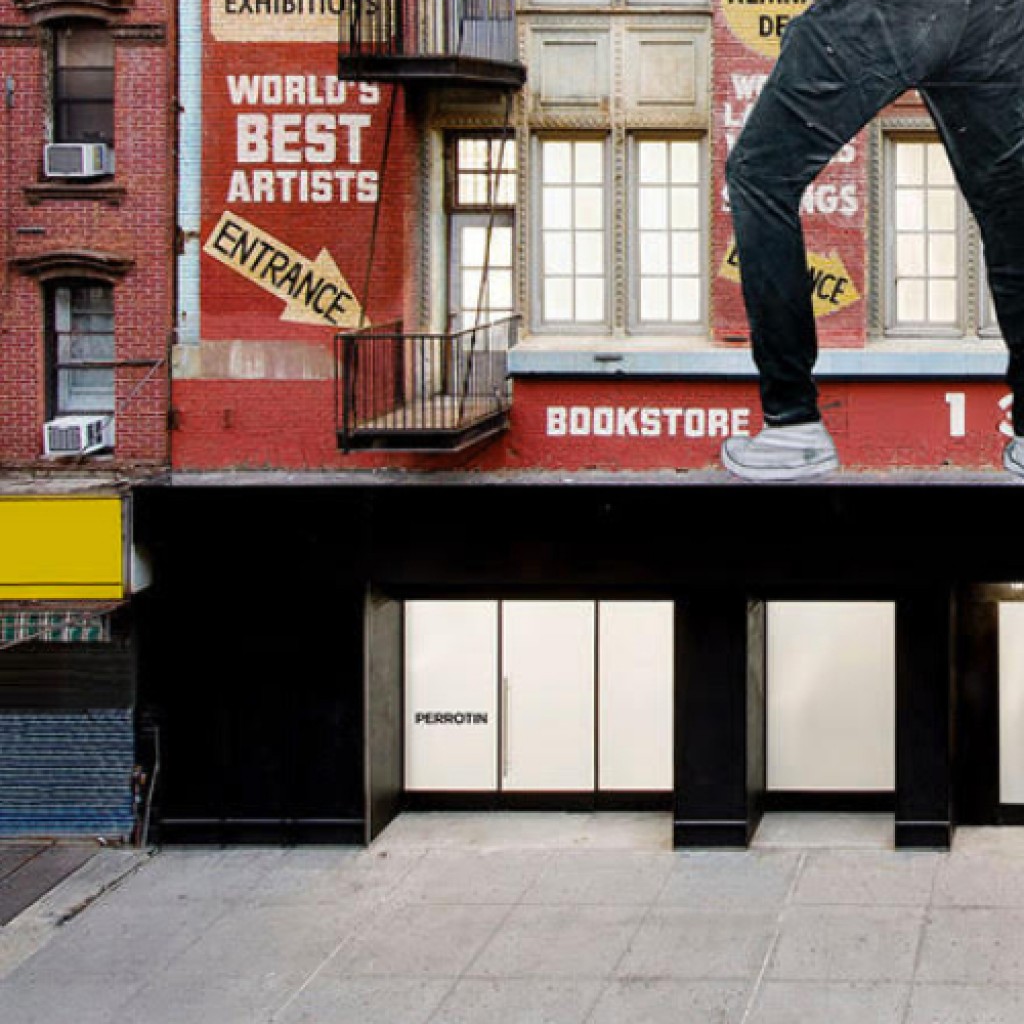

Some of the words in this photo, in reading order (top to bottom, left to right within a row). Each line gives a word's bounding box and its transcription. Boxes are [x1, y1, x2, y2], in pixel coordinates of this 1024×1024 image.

[226, 75, 380, 105] WORLD'S
[236, 114, 372, 163] BEST
[226, 170, 378, 203] ARTISTS
[212, 220, 353, 324] ENTRANCE
[546, 406, 750, 436] BOOKSTORE
[415, 712, 488, 724] PERROTIN
